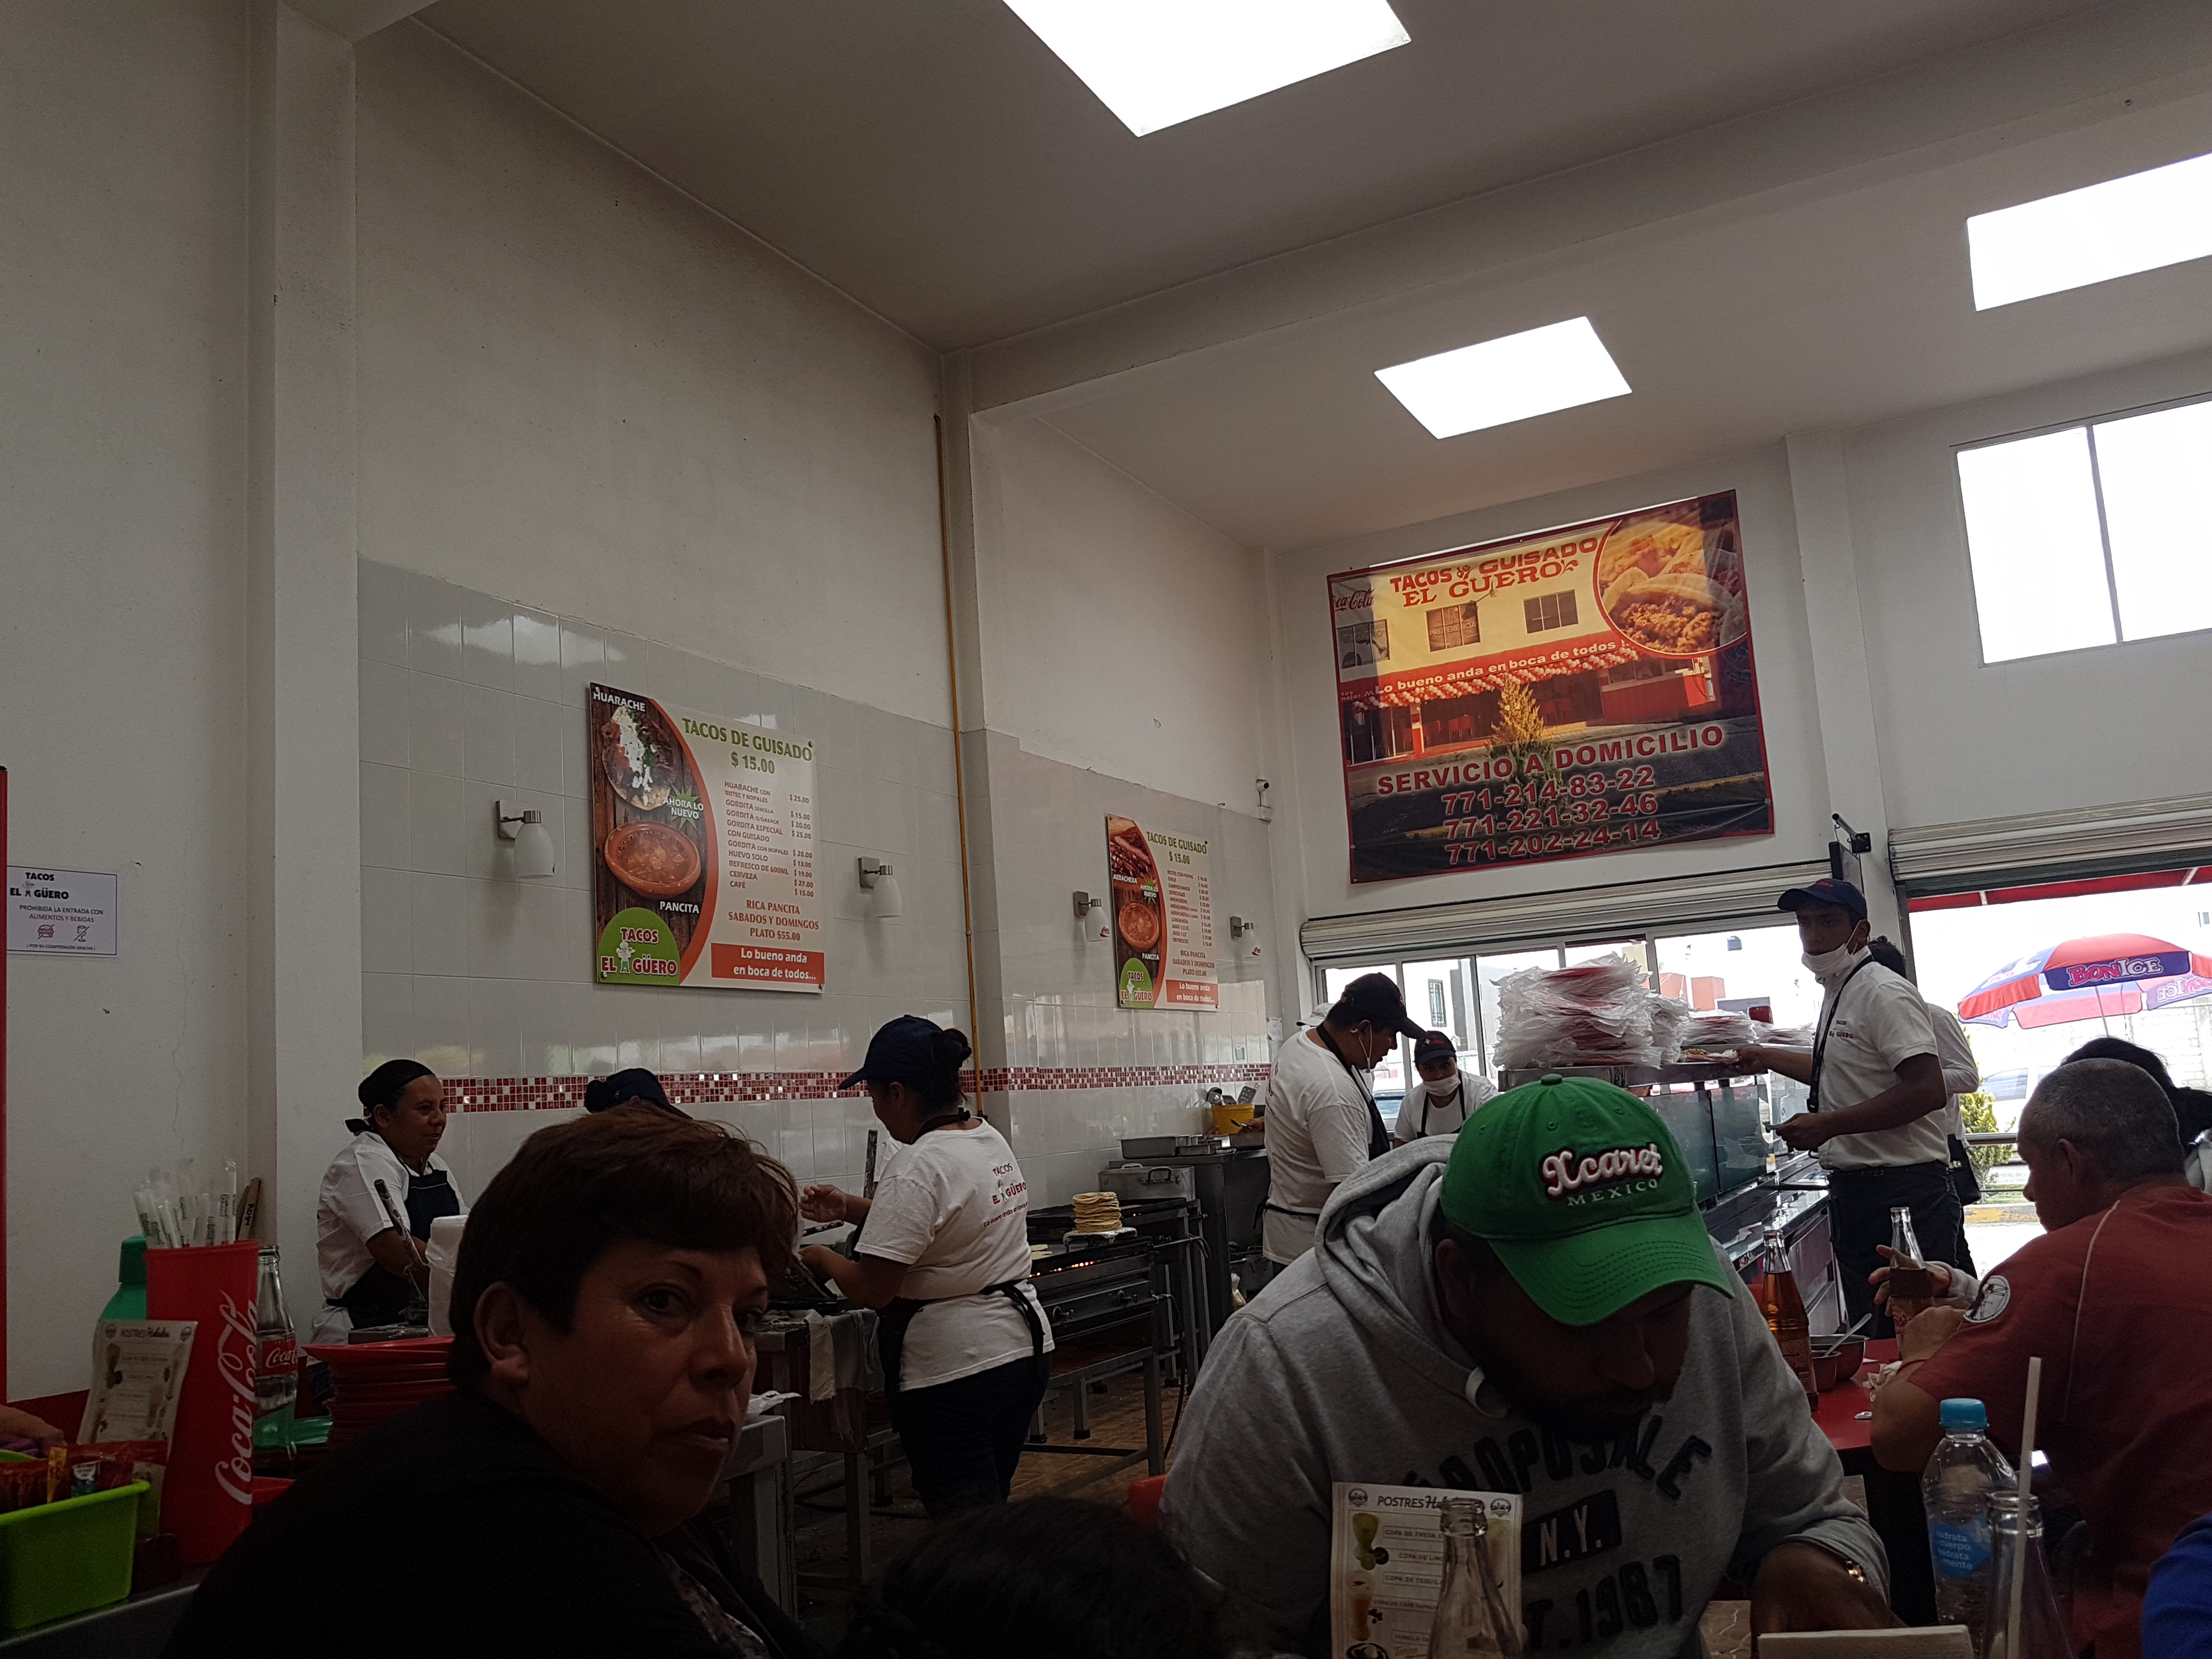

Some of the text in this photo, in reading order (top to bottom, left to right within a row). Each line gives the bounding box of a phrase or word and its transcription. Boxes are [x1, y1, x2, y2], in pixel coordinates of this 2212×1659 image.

[1390, 537, 1599, 593] TACOS GUISADO
[1402, 588, 1437, 607] EL
[1375, 641, 1616, 695] Lo bueno anda en boca de todos
[593, 692, 646, 712] HUARACHE
[682, 718, 812, 761] TACOS DE GUISADO
[742, 755, 775, 774] 15.00
[1378, 725, 1724, 795] SERVICIO A DOMICILIO
[724, 781, 759, 793] HUARACHE
[1442, 766, 1655, 815] 771-214-83-22
[664, 798, 704, 811] AHORA LO
[746, 794, 768, 803] NOPALES
[794, 795, 809, 804] 25.00
[671, 808, 699, 819] NUEVO
[726, 799, 754, 810] GORDITA
[795, 812, 810, 821] 15.00
[1444, 793, 1658, 840] 771-221-32-46
[726, 809, 754, 820] GORDITA
[795, 822, 811, 830] 20.00
[727, 819, 755, 830] GORDITA
[756, 825, 783, 835] ESPECIAL
[796, 831, 811, 839] 25.00
[742, 832, 770, 842] GUISADO
[728, 840, 756, 850] GORDITA
[797, 850, 812, 859] 20.00
[1146, 831, 1207, 854] TACOS DE GUISADO
[1446, 819, 1661, 865] 771-202-24-14
[729, 850, 751, 859] HUEVO
[752, 853, 768, 862] SOLO
[1174, 853, 1190, 865] 15.00
[729, 860, 760, 870] REFRESCO
[770, 866, 789, 875] 600ML
[25, 872, 54, 881] TACOS
[729, 871, 758, 880] CERVEZA
[798, 880, 814, 888] 27.00
[730, 881, 746, 889] CAFÉ
[10, 887, 69, 900] EL GÜERO
[659, 901, 699, 914] PANCITA
[746, 900, 800, 915] RICA PANCITA
[729, 911, 819, 930] SABADOS Y DOMINGOS
[620, 927, 658, 944] TACOS
[750, 928, 800, 941] PLATO $55.00
[741, 947, 807, 963] Lo bueno anda
[601, 953, 678, 977] EL GÜERO
[733, 966, 745, 975] en
[748, 965, 769, 977] boca
[771, 967, 782, 978] de
[1127, 971, 1144, 981] TACOS
[1121, 990, 1128, 1001] EL
[992, 1163, 1013, 1177] TACOS
[1542, 1142, 1663, 1197] Xcaret
[992, 1182, 1027, 1205] EL GÜERO
[1567, 1178, 1658, 1206] MEXICO
[1378, 1496, 1424, 1509] POSTRES
[1539, 1504, 1603, 1567] N.Y.
